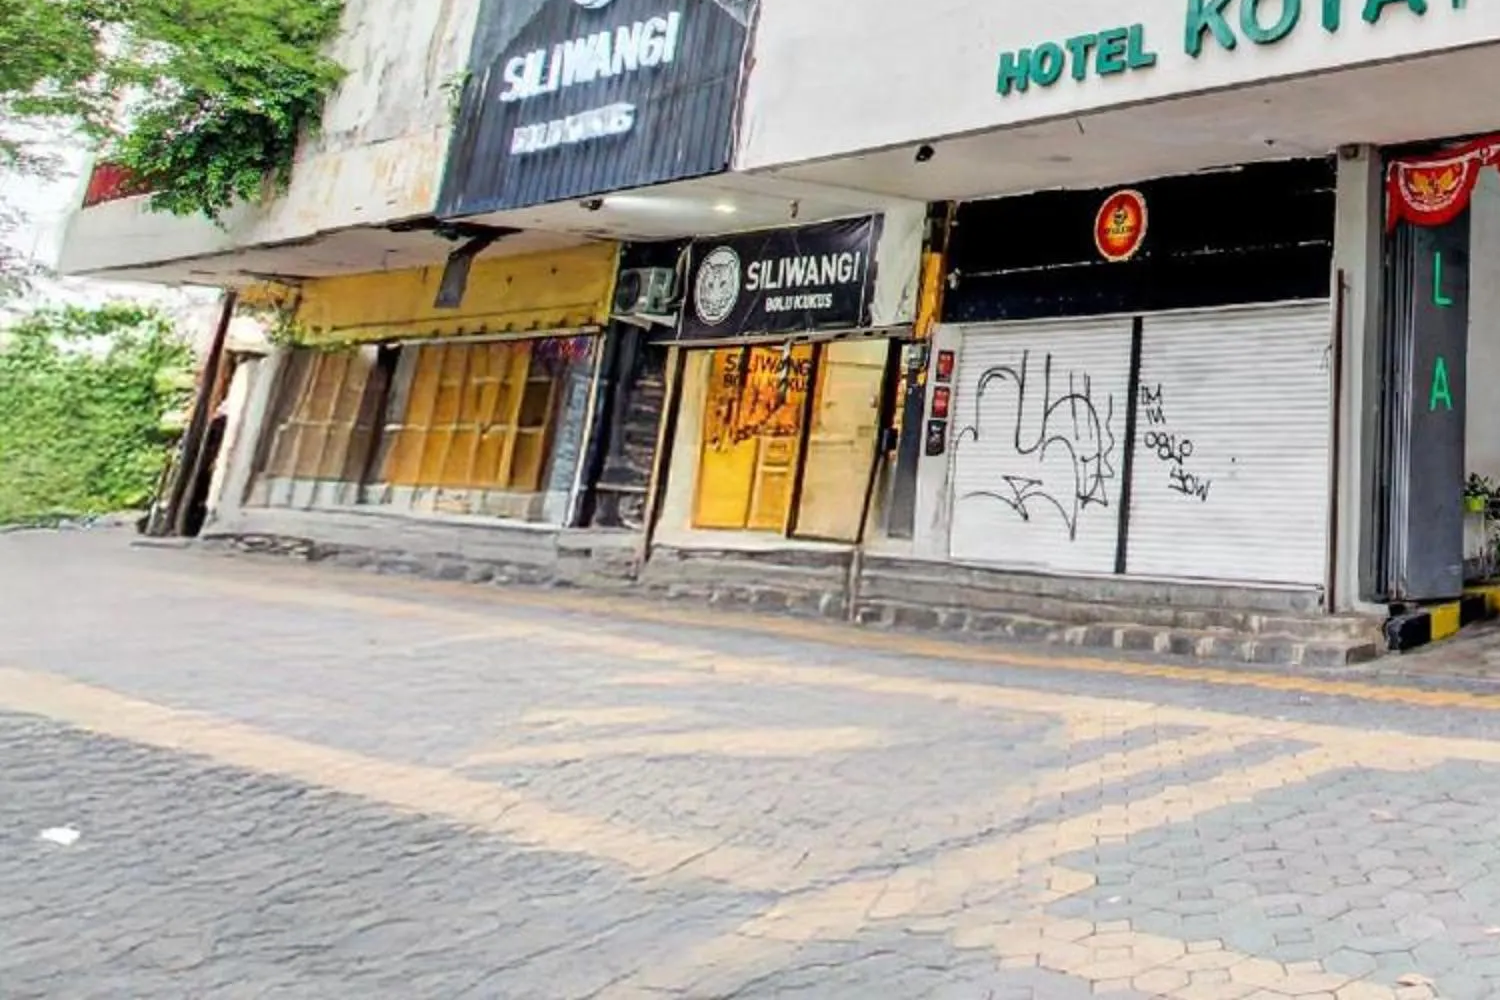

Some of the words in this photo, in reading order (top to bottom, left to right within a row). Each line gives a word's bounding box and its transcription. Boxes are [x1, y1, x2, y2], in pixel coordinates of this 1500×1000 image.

[499, 11, 680, 102] SILIWANGI
[997, 24, 1156, 95] HOTEL
[745, 251, 861, 291] SILIWANGI
